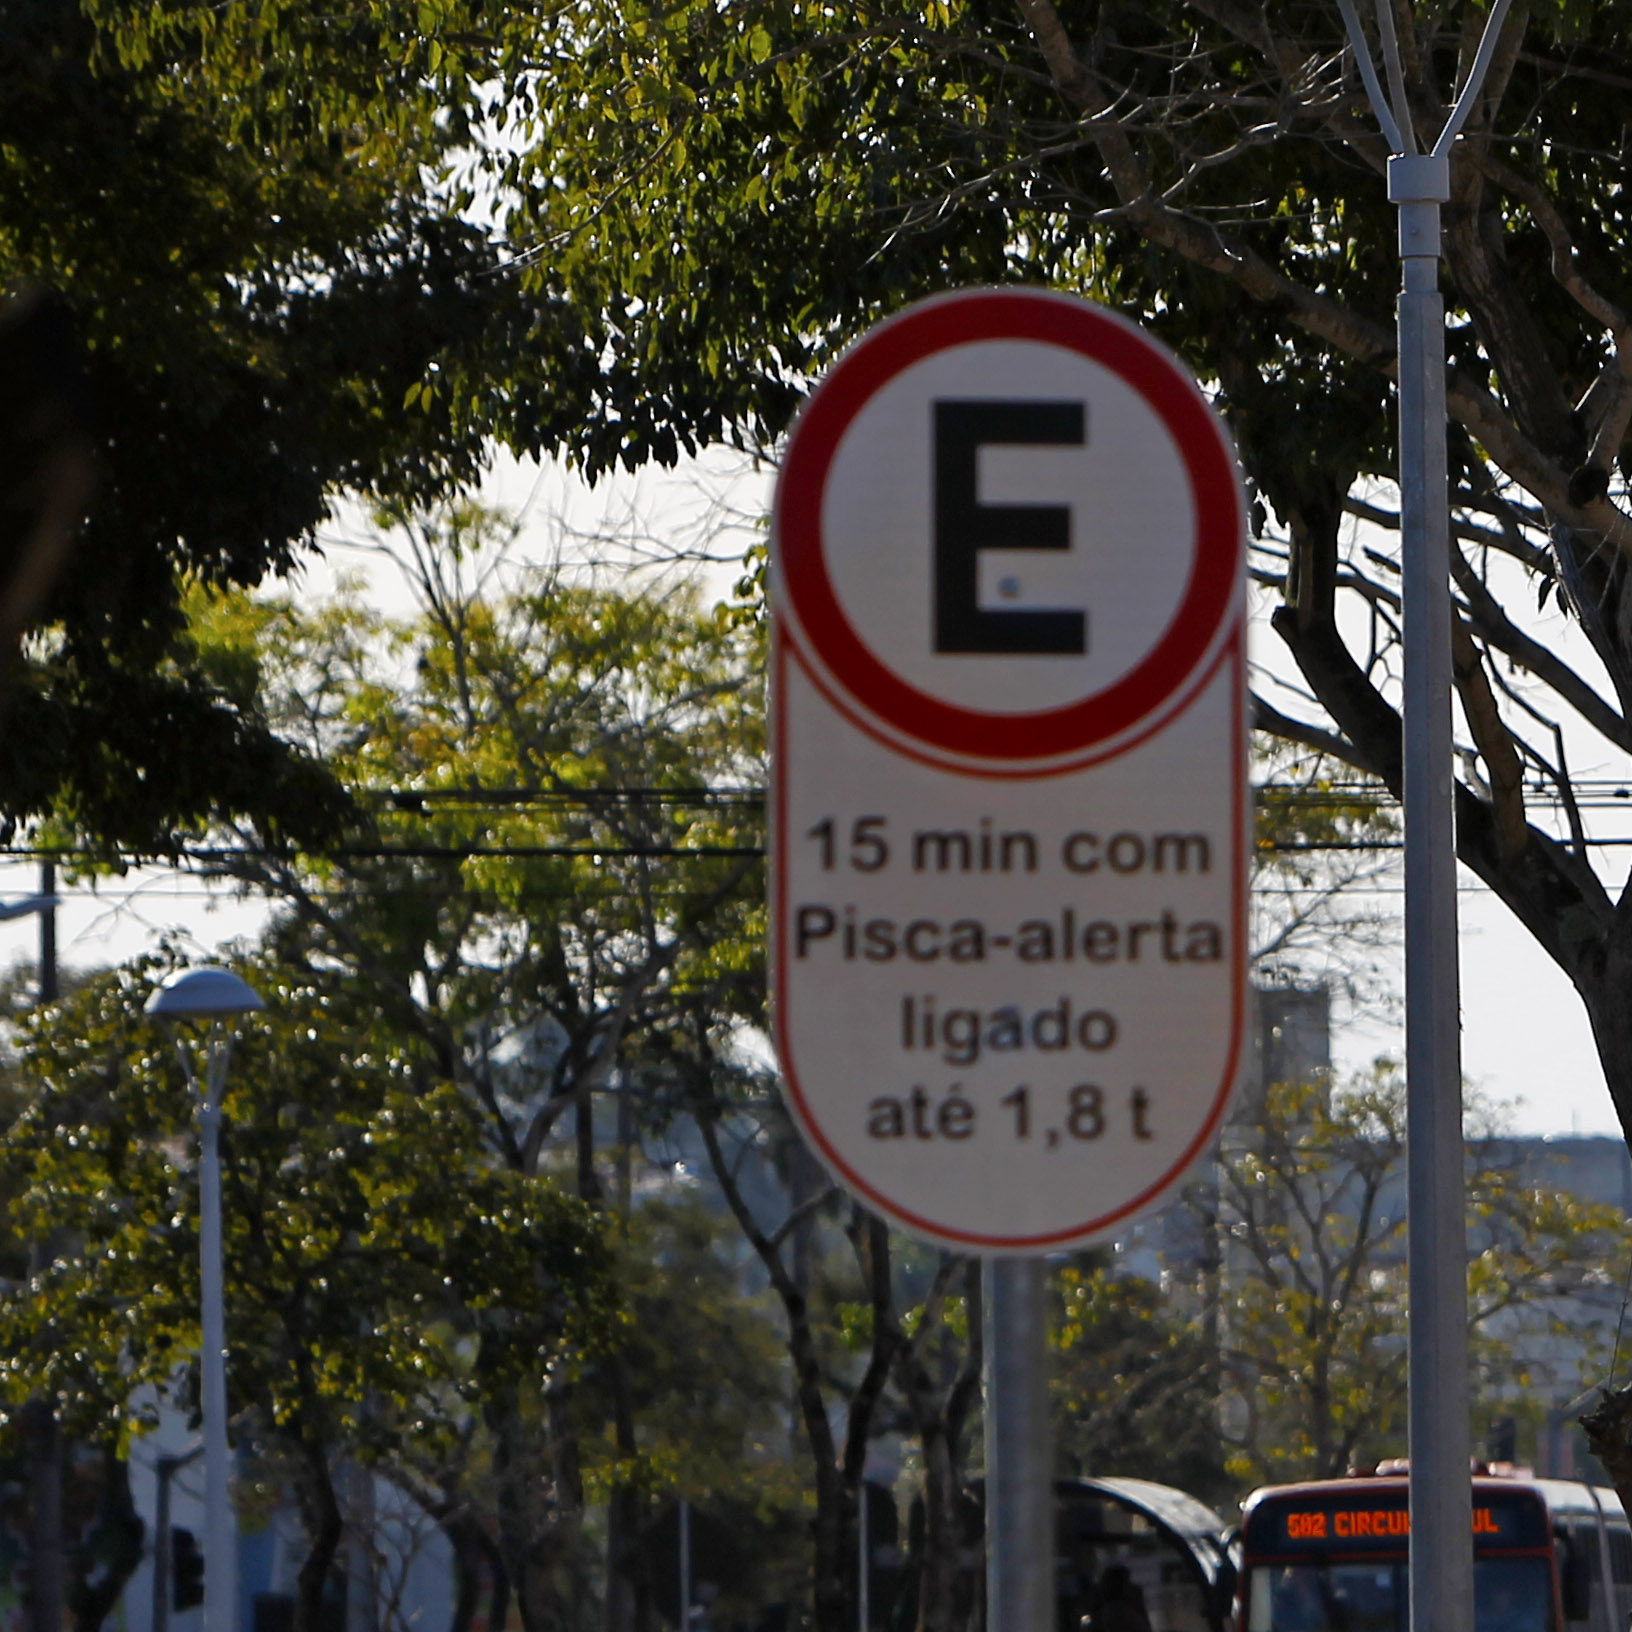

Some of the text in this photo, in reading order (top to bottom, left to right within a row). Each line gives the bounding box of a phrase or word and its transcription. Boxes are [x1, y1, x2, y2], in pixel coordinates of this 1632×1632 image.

[932, 399, 1086, 654] E
[807, 816, 1211, 874] 15 min com
[796, 904, 1225, 964] Pisca-alerta
[901, 996, 1118, 1067] ligado
[867, 1083, 1154, 1150] até 1,8 t
